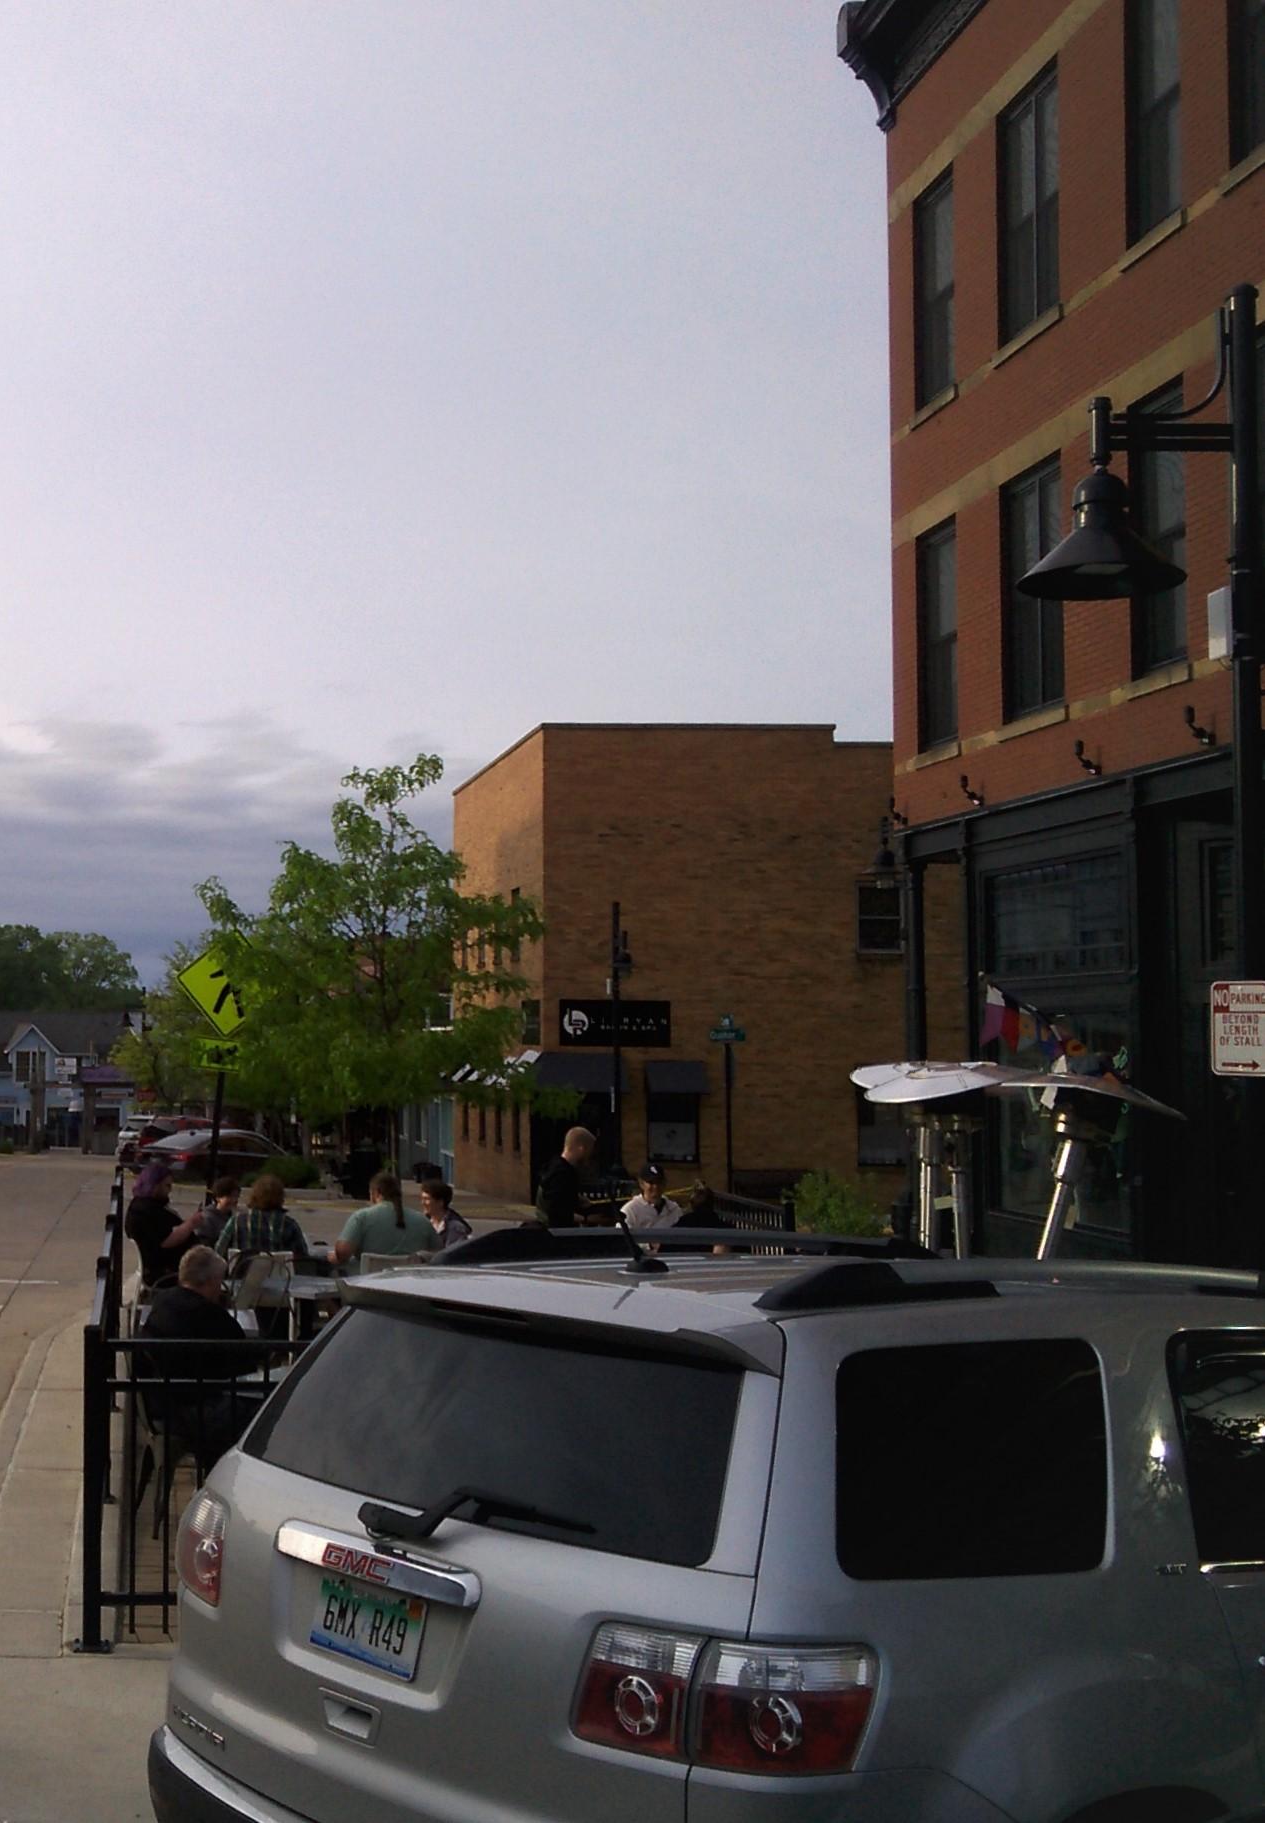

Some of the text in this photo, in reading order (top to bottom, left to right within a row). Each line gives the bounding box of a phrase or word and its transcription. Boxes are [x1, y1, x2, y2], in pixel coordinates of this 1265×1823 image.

[1214, 988, 1229, 1007] NO
[1222, 1014, 1260, 1024] BEYOND
[1223, 1025, 1259, 1036] LENGTH
[1219, 1036, 1263, 1047] OF STALL
[321, 1542, 394, 1585] GMC
[322, 1594, 362, 1640] 6MX
[368, 1608, 409, 1656] R49
